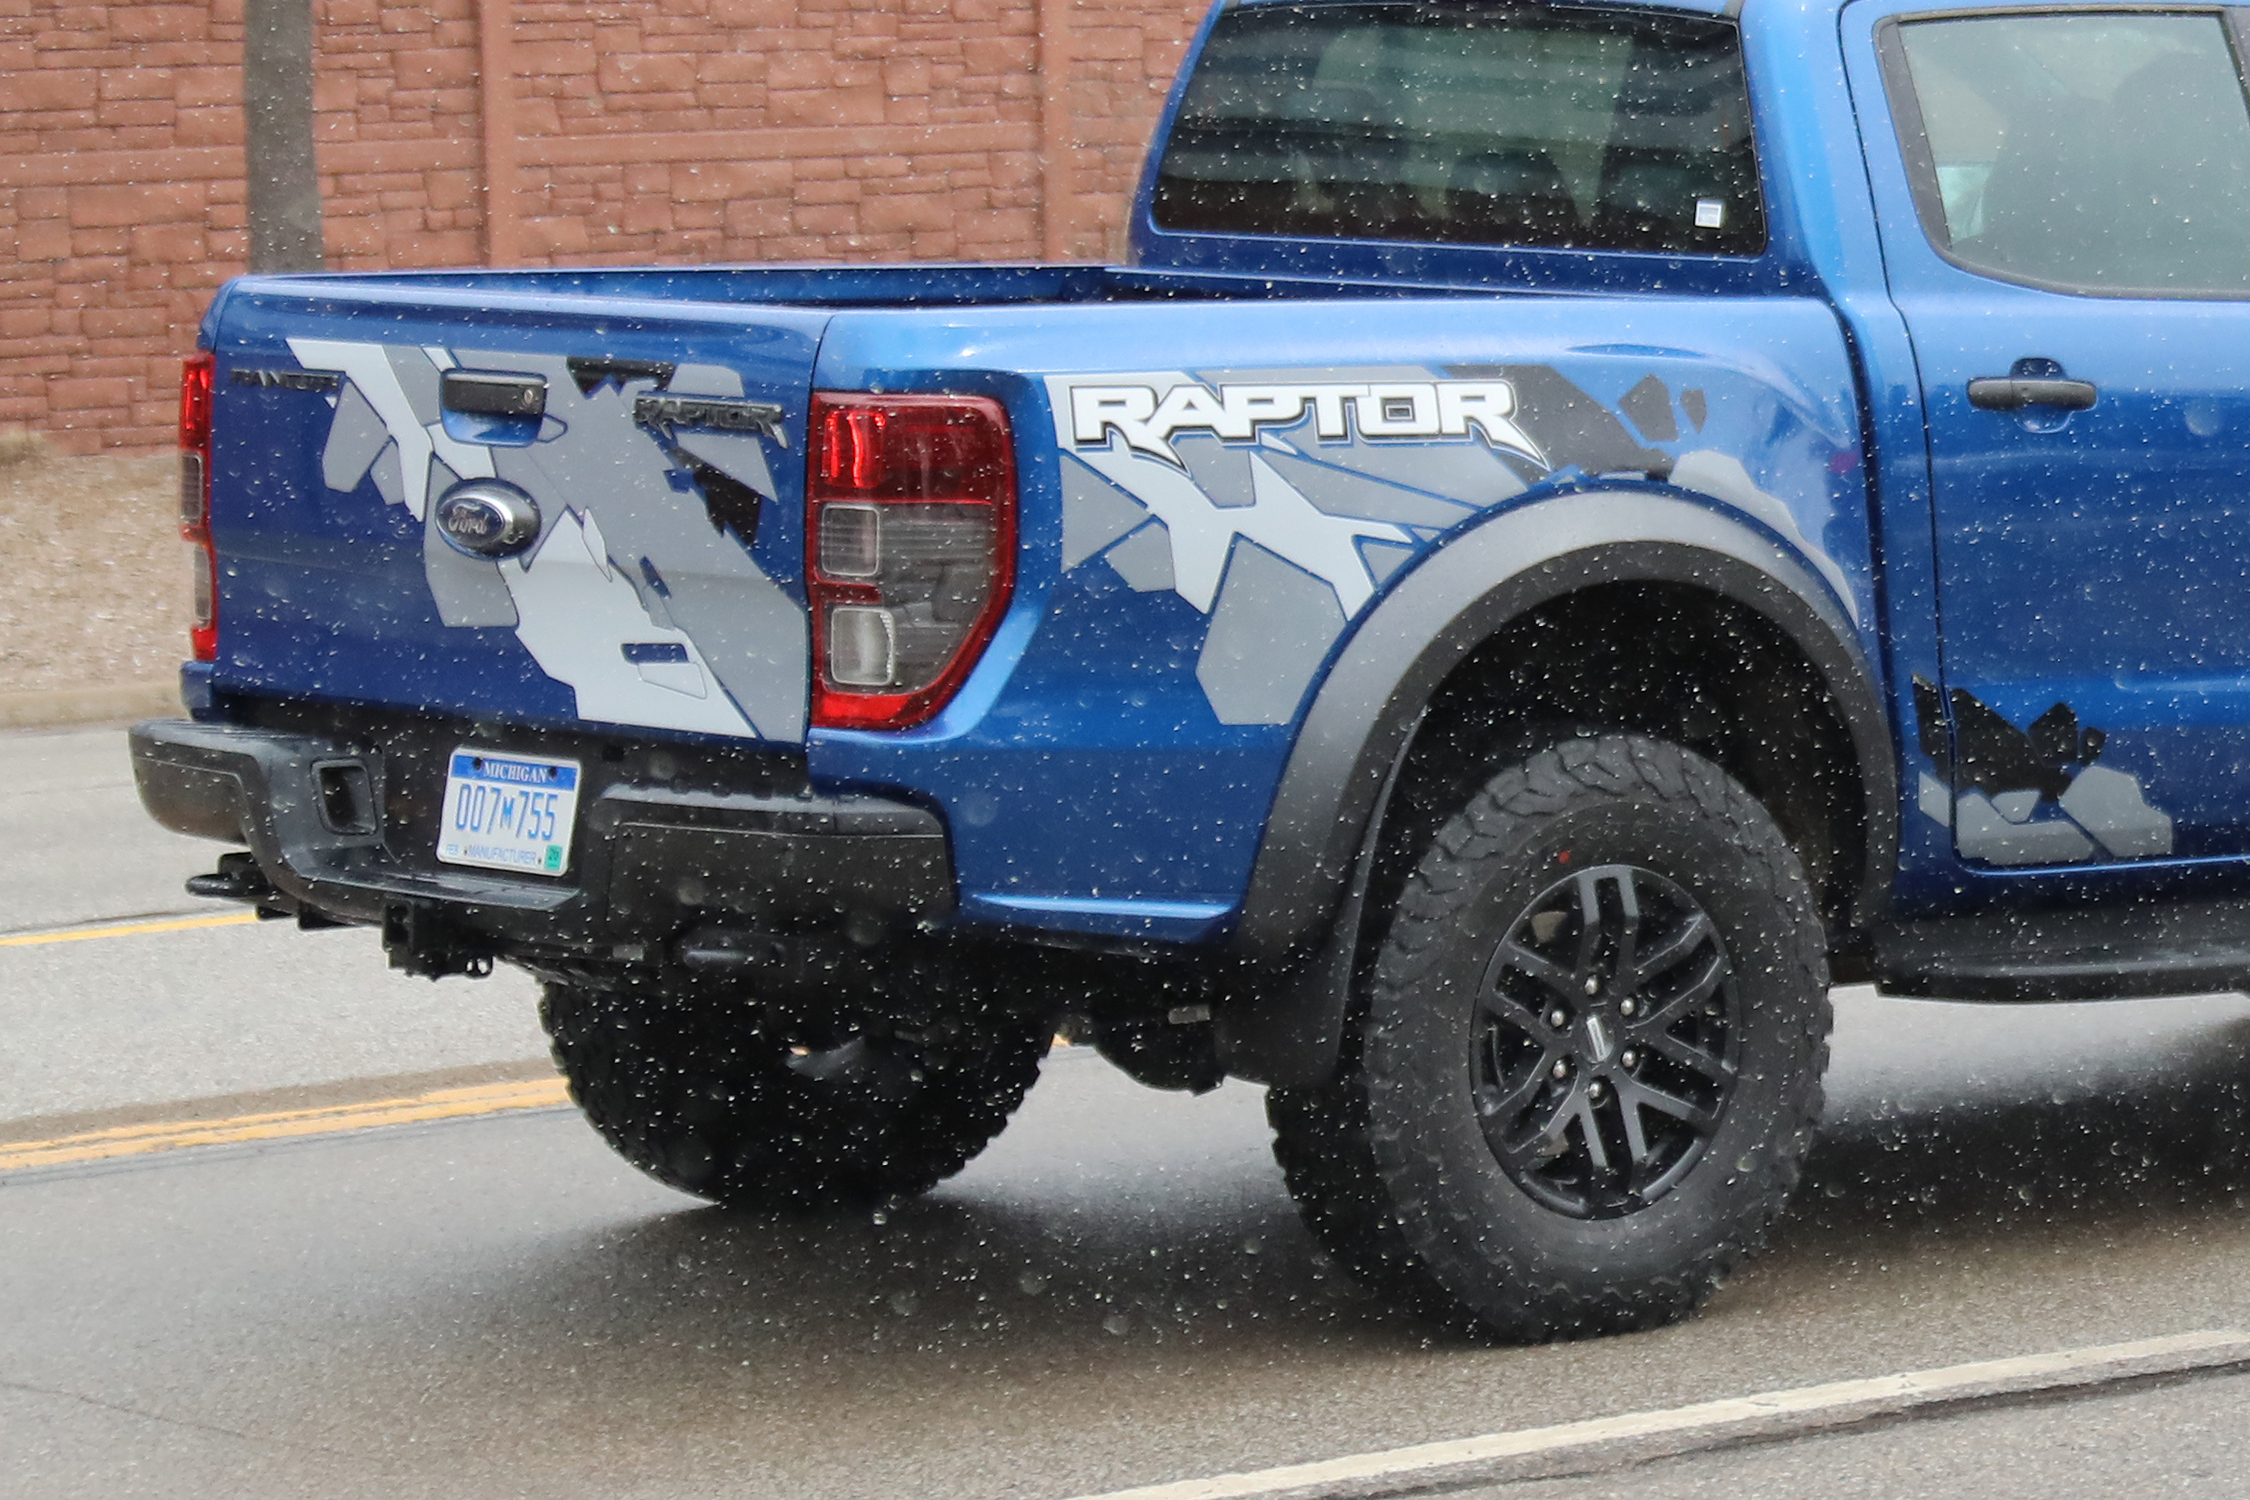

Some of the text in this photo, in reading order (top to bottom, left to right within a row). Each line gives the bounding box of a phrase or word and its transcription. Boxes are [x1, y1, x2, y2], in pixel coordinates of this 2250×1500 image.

[634, 397, 788, 448] RAPTOR
[1069, 382, 1551, 474] RAPTOR
[448, 503, 490, 535] Ford
[483, 761, 548, 783] MICHIGAN
[468, 844, 537, 865] MANUFACTURER
